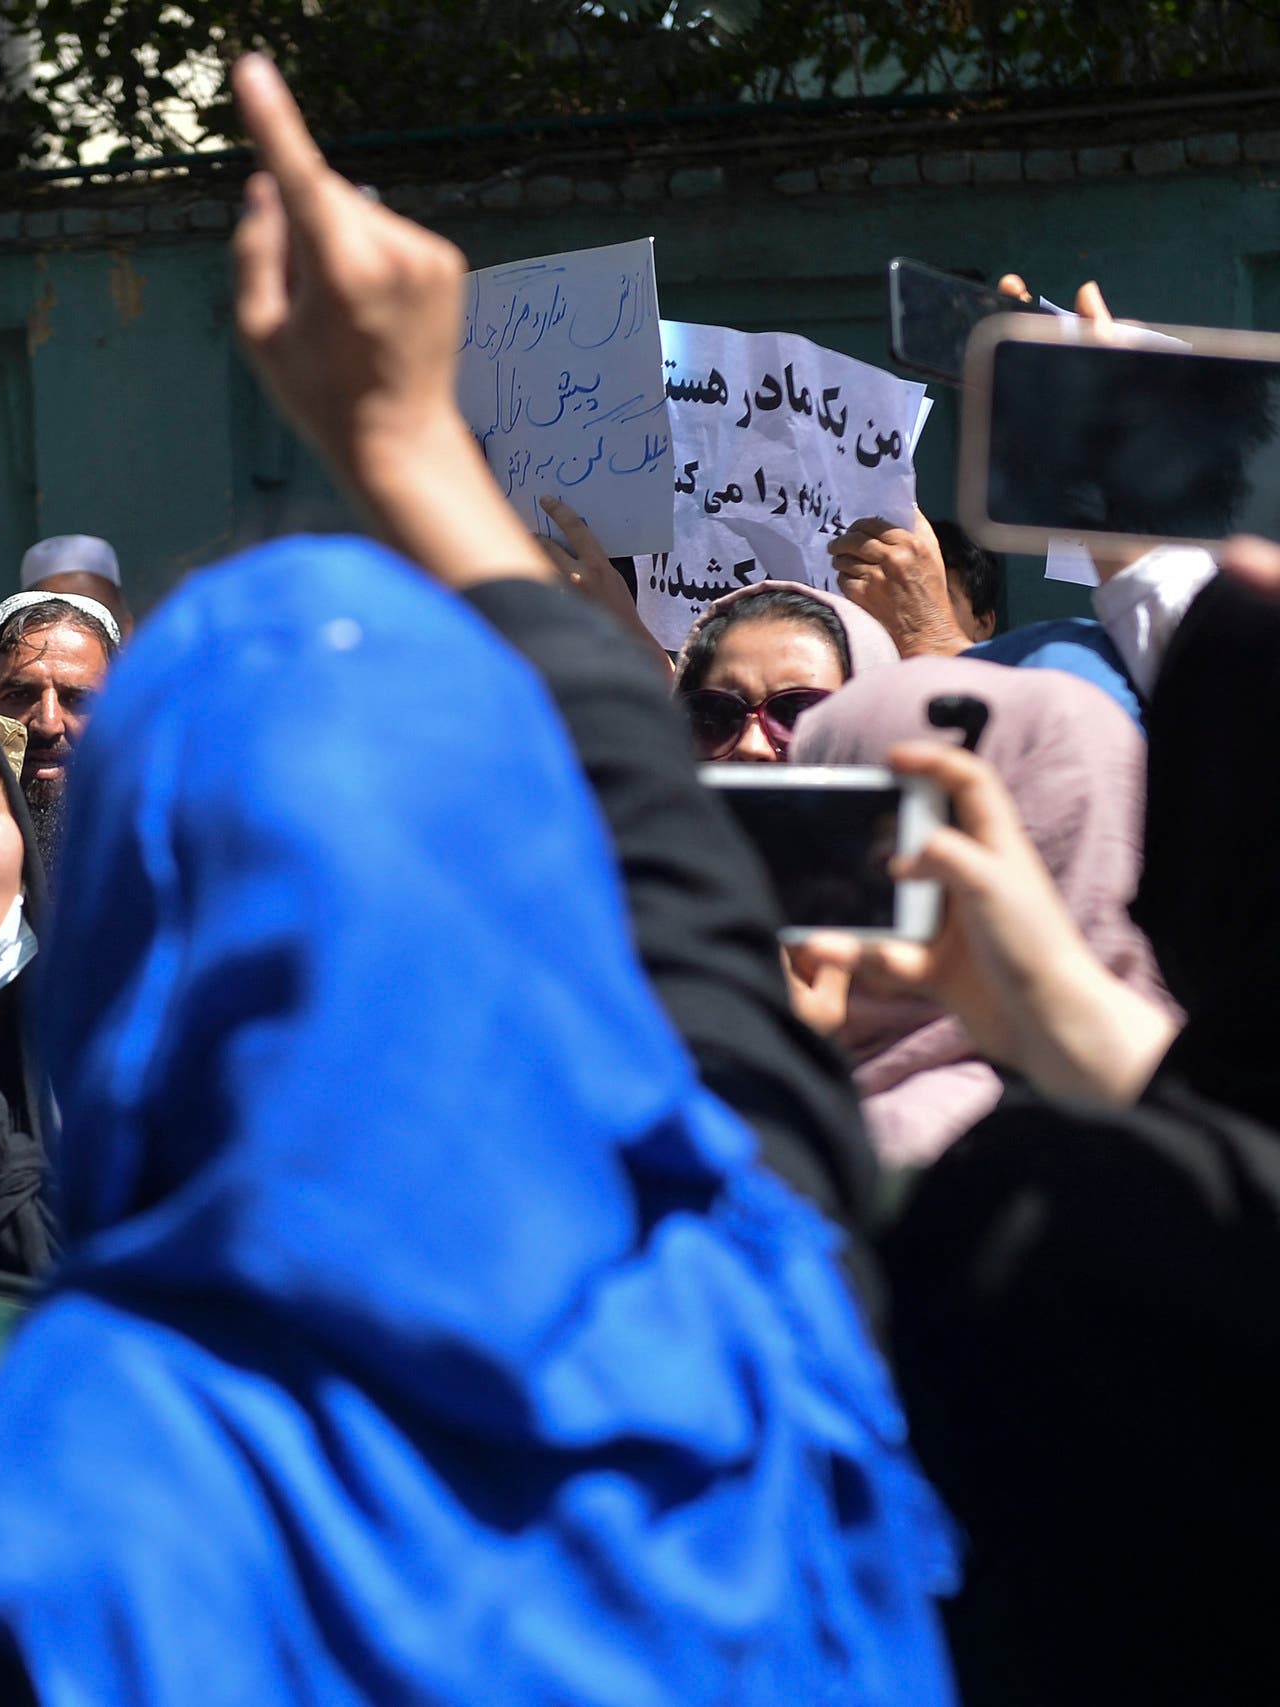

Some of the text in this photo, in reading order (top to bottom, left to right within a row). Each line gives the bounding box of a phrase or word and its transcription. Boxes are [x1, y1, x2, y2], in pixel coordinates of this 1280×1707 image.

[525, 370, 601, 427] پیش
[664, 359, 903, 468] من یک مادر هست
[703, 482, 744, 514] می
[754, 466, 788, 515] را
